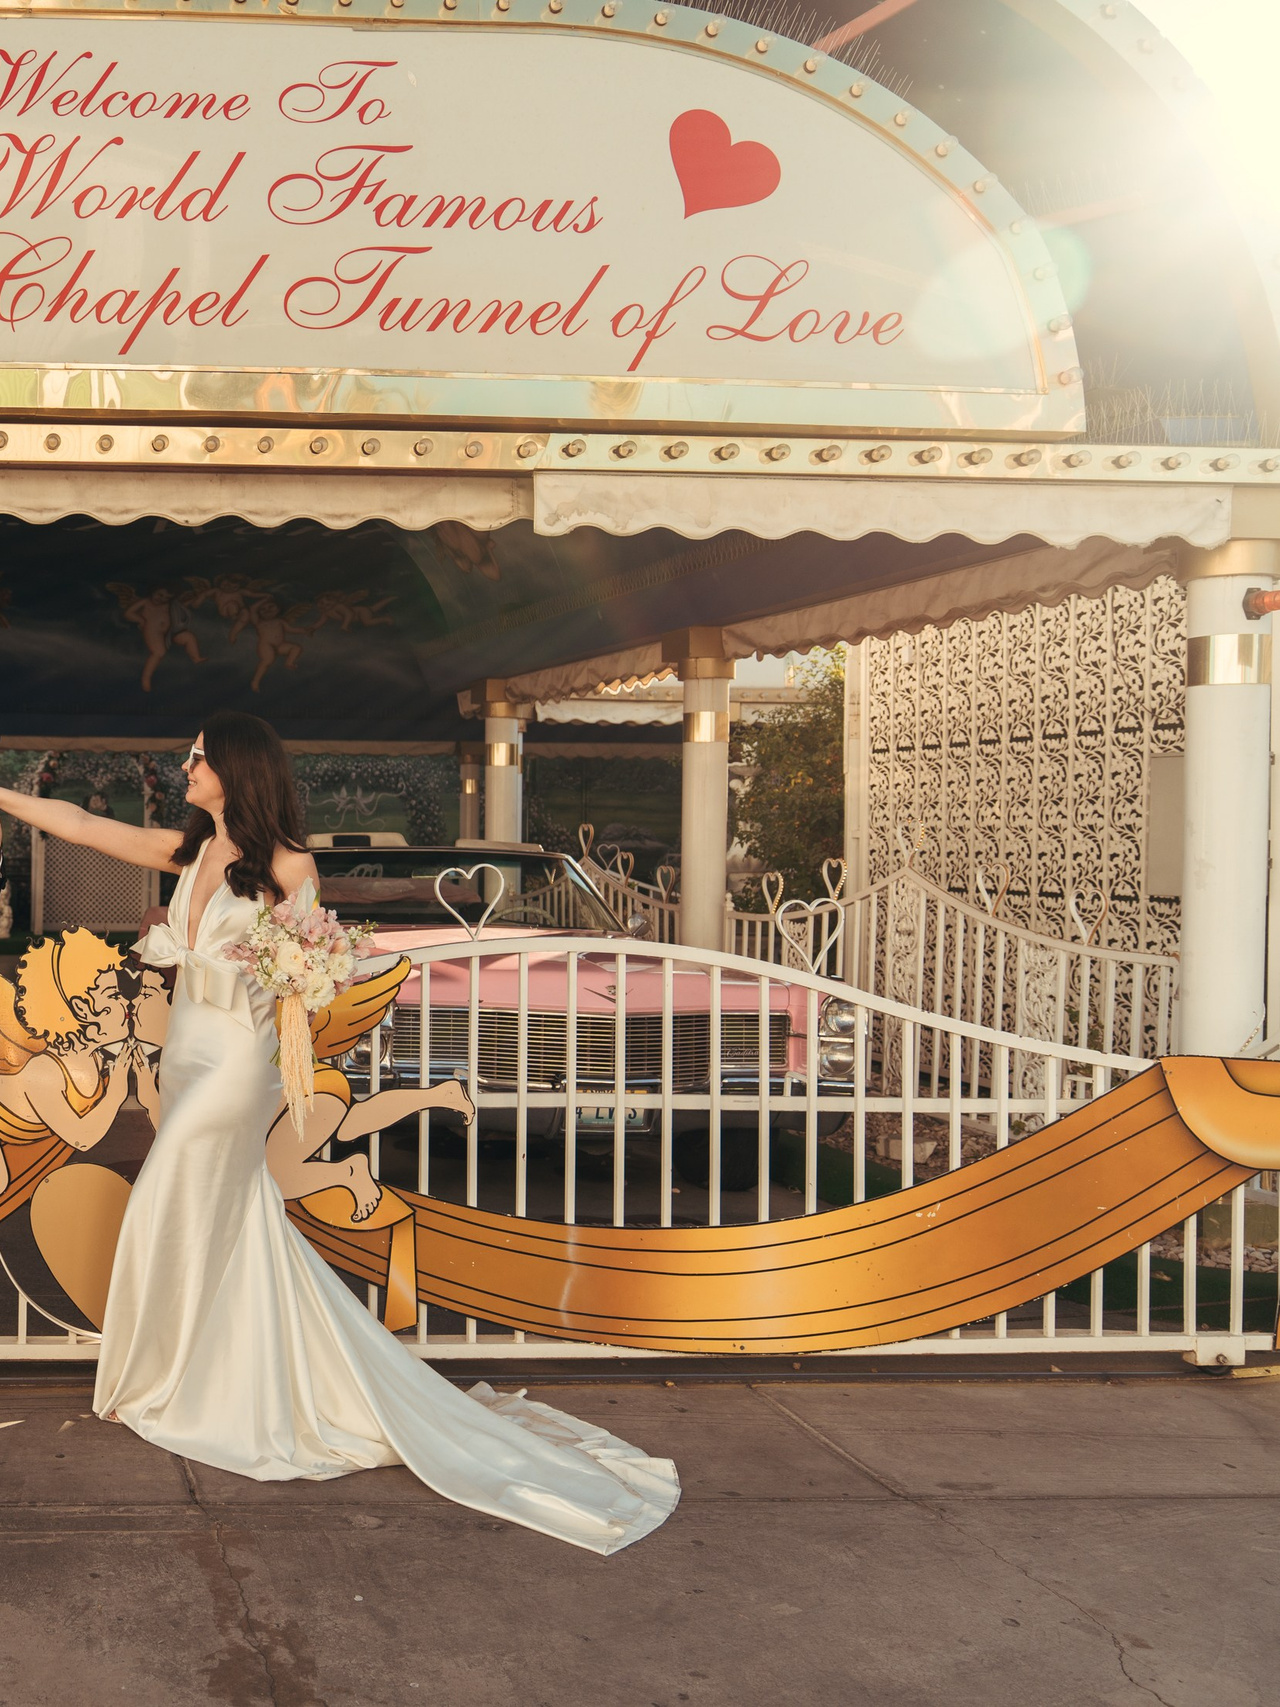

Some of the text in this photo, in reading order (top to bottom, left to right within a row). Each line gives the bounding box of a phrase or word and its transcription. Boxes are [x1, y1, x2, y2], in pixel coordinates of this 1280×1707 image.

[278, 60, 398, 126] To
[267, 144, 604, 235] Famous
[282, 245, 610, 338] Tunnel
[610, 265, 707, 373] of
[706, 254, 905, 347] Love
